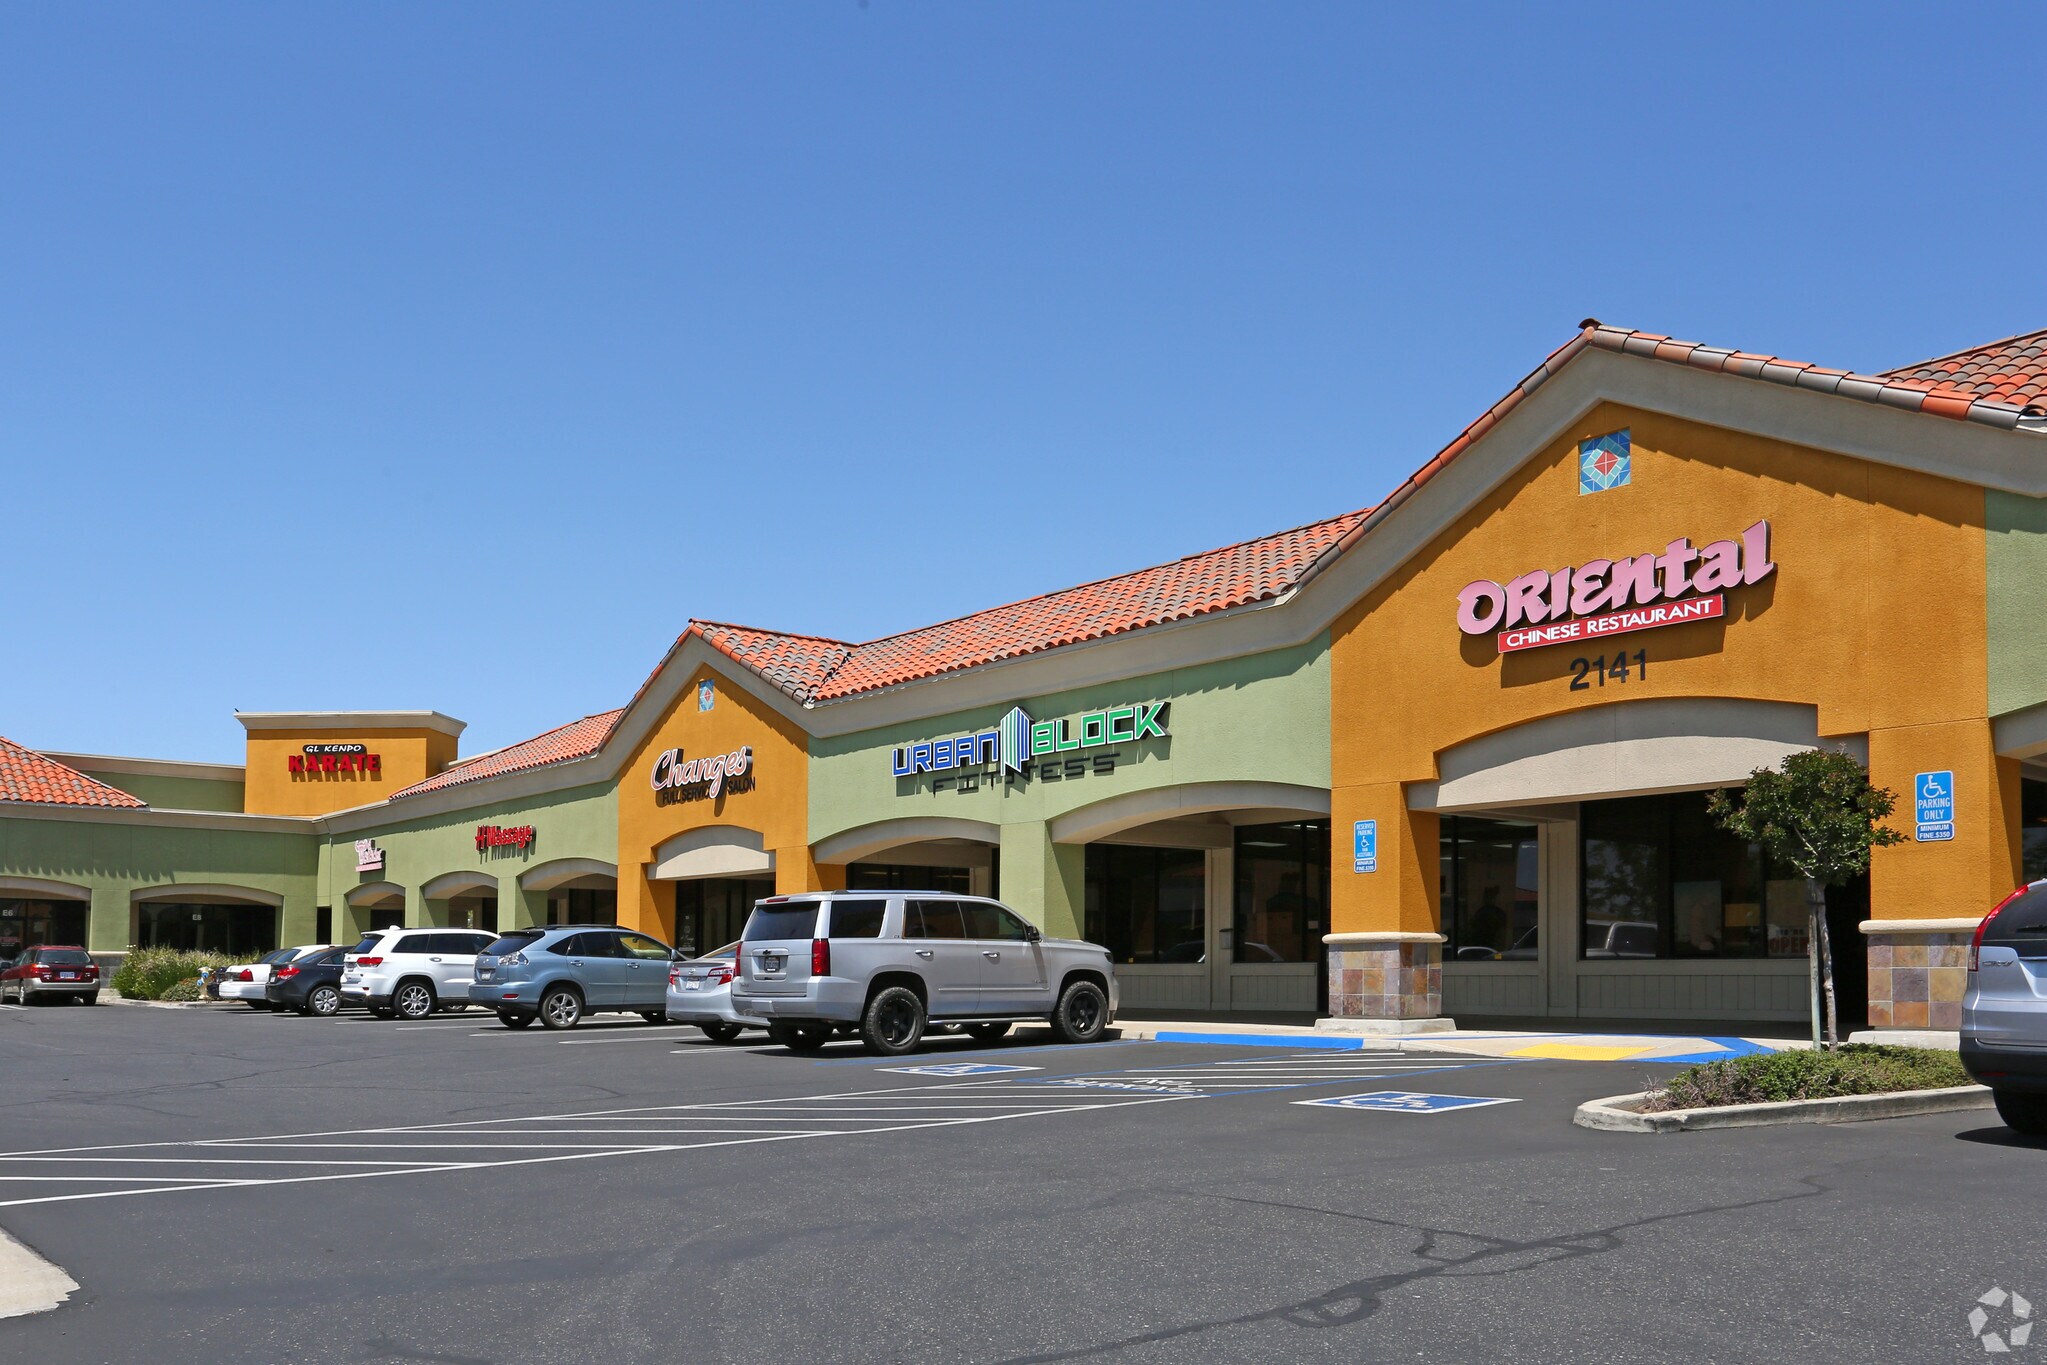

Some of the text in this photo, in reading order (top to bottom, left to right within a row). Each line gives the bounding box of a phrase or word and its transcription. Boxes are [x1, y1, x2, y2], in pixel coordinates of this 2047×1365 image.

[1506, 599, 1714, 648] CHINESE RESTAURANT
[1569, 648, 1647, 692] 2141
[305, 744, 362, 753] GL KENPO
[892, 701, 1167, 777] URBAN BLOCK
[288, 753, 381, 773] KARATE
[650, 745, 752, 799] Changes
[662, 776, 756, 805] FULL SERVIC SALON
[1918, 797, 1951, 809] PARKING
[1924, 809, 1945, 820] ONLY
[487, 824, 533, 848] Massage
[2, 909, 14, 917] E6
